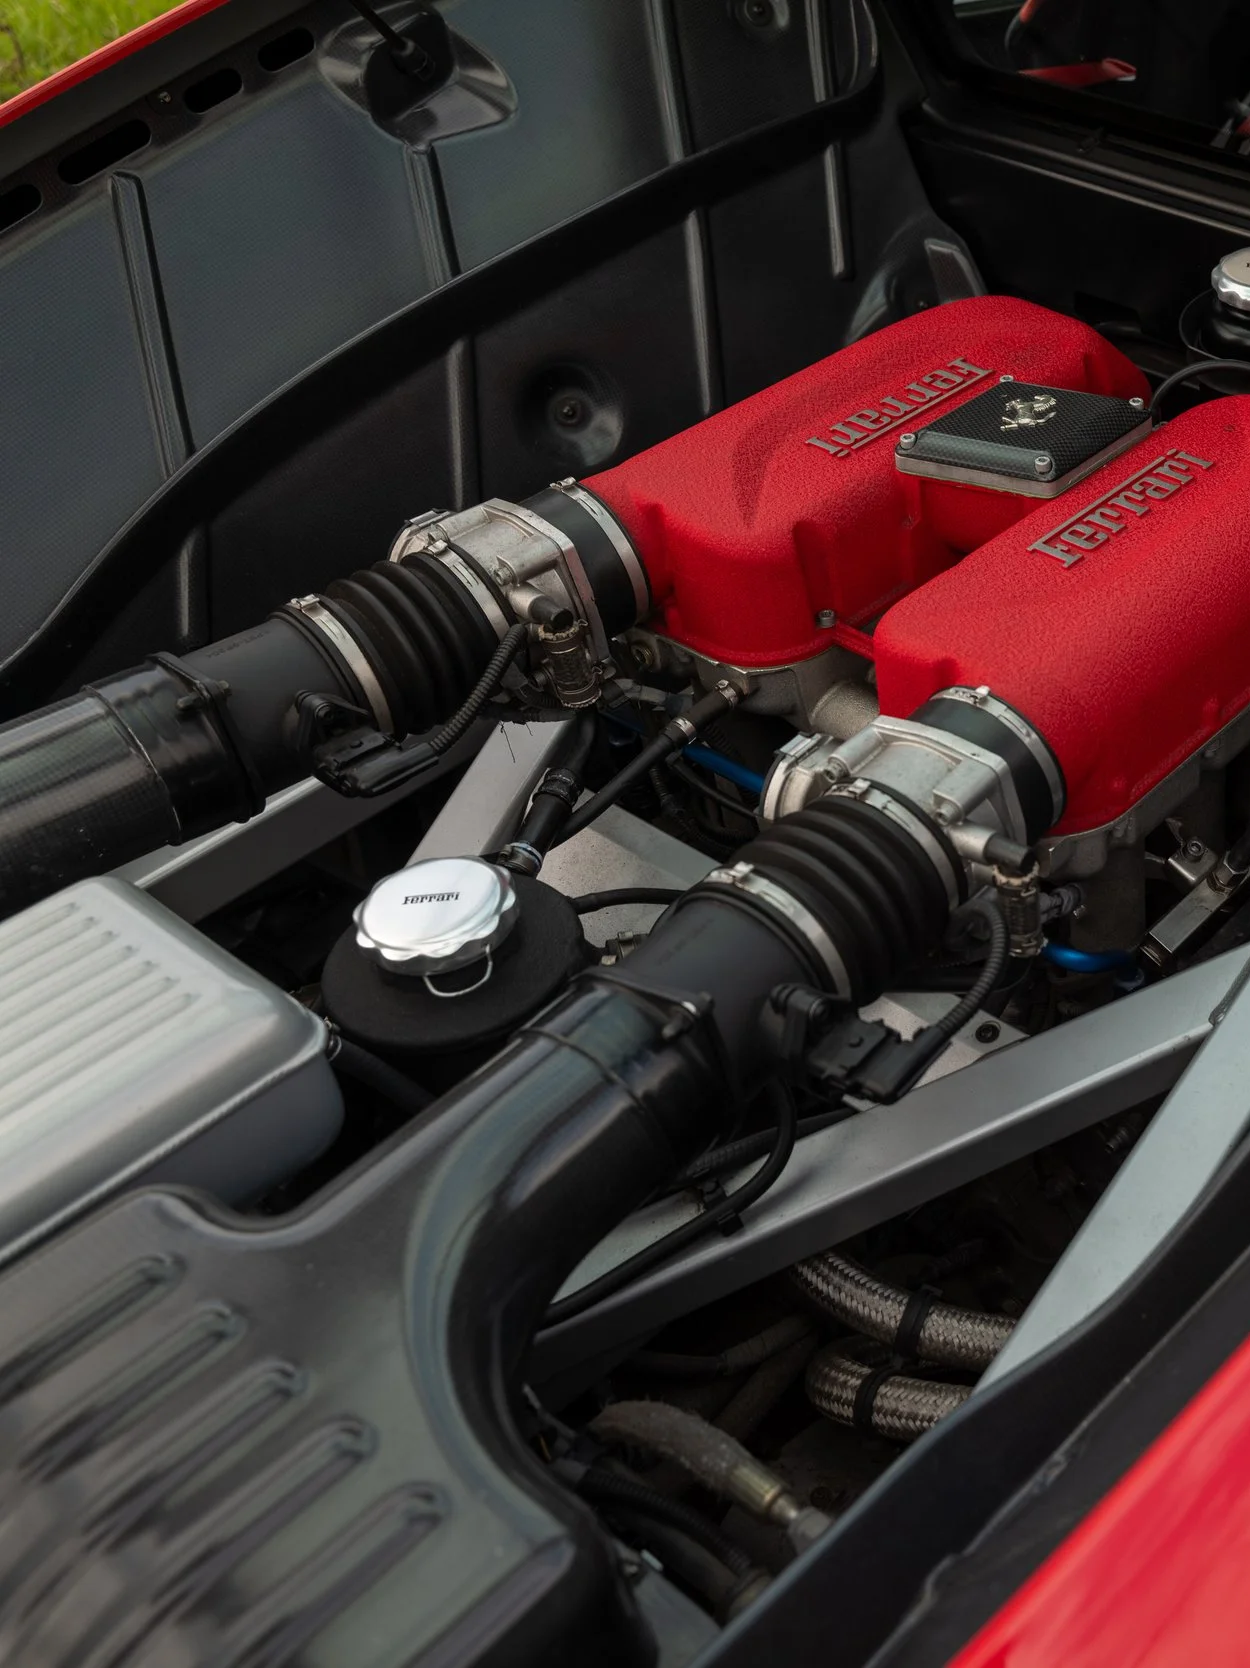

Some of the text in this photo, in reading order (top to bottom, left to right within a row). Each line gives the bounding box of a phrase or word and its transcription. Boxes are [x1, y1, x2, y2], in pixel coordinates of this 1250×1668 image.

[805, 356, 993, 458] Ferrari
[1027, 447, 1214, 568] Ferrari
[403, 891, 460, 905] Ferrari
